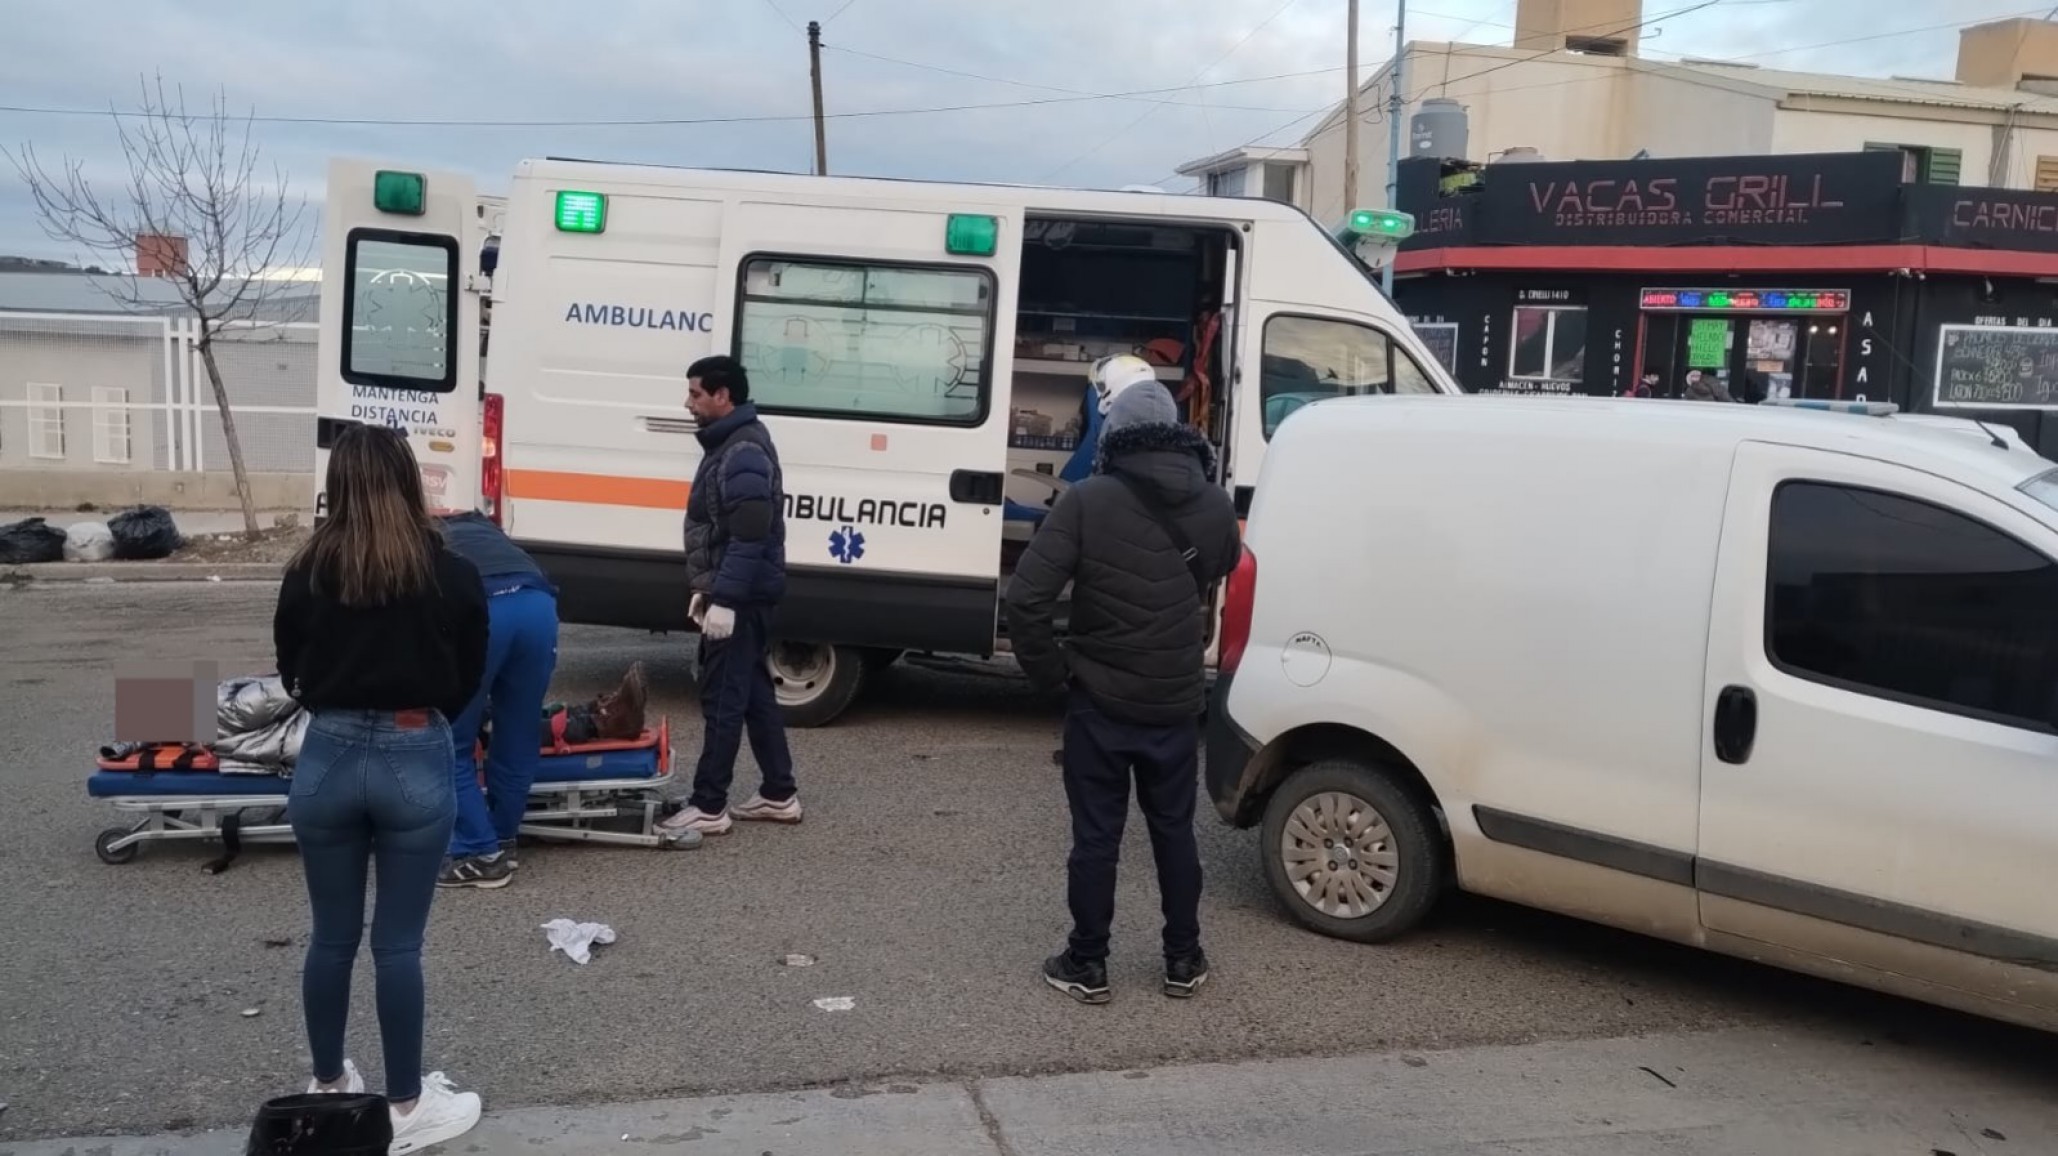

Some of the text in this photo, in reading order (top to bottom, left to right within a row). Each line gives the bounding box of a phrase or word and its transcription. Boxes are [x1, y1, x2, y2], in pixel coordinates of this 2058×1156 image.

[1530, 174, 1844, 213] VACAS GRILL
[1555, 209, 1809, 227] DISTRIBUIDORA COMERCIAL
[1954, 200, 2058, 232] CARNIC
[565, 303, 713, 332] AMBULANC
[352, 385, 439, 404] MANTENGA
[351, 404, 438, 424] DISTANCIA
[783, 494, 946, 529] BULANCIA
